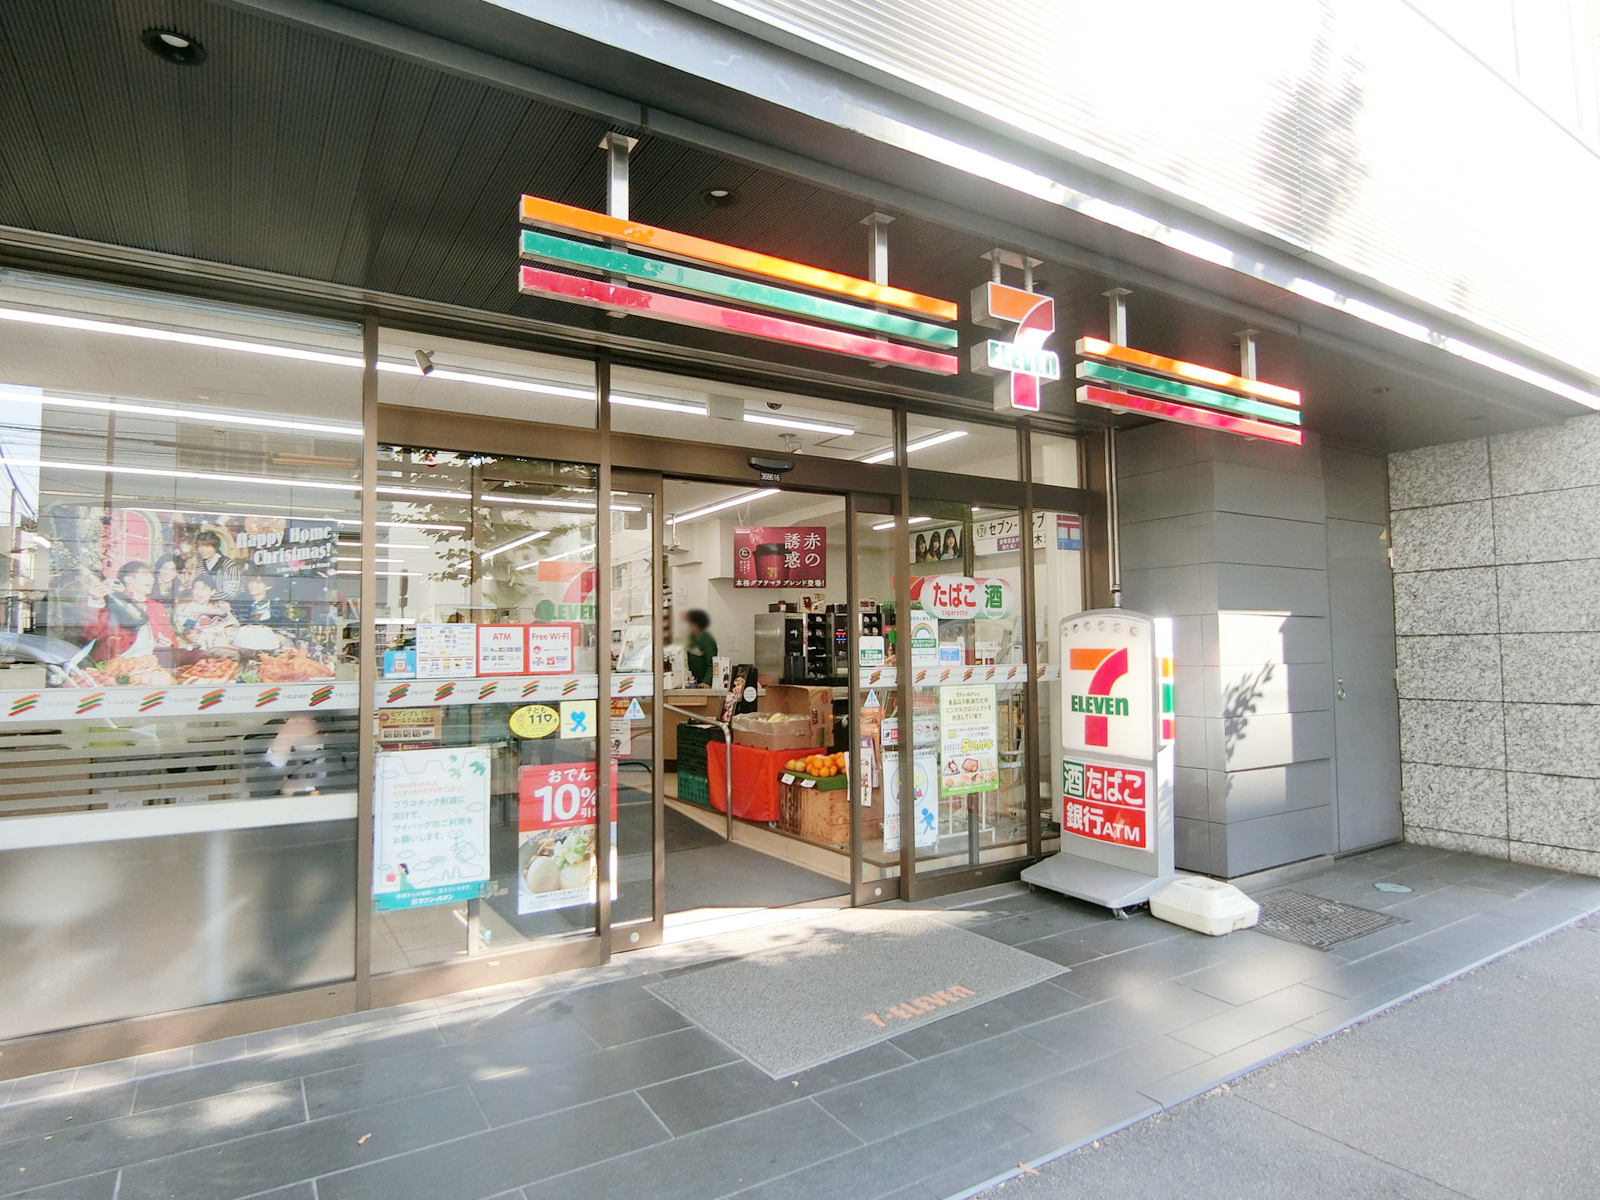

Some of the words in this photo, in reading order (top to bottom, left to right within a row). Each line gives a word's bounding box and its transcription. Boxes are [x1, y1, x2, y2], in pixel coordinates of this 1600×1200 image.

[236, 531, 285, 549] Happy
[289, 526, 332, 543] Home
[253, 542, 332, 566] Christmas!
[784, 532, 801, 568] 誘惑
[803, 532, 821, 567] 赤の
[933, 582, 977, 608] たばこ
[984, 584, 1003, 609] 酒
[941, 609, 968, 617] cigarette
[492, 632, 512, 641] ATM
[531, 633, 549, 641] Free
[549, 632, 570, 641] Wi-Fi
[526, 706, 547, 714] 子ども
[548, 767, 592, 784] おでん
[1063, 761, 1084, 798] 酒
[1086, 767, 1144, 806] たばこ
[393, 795, 466, 809] プラスチック削減に
[533, 783, 597, 822] 10%
[392, 816, 474, 832] マイバッグのご利用を
